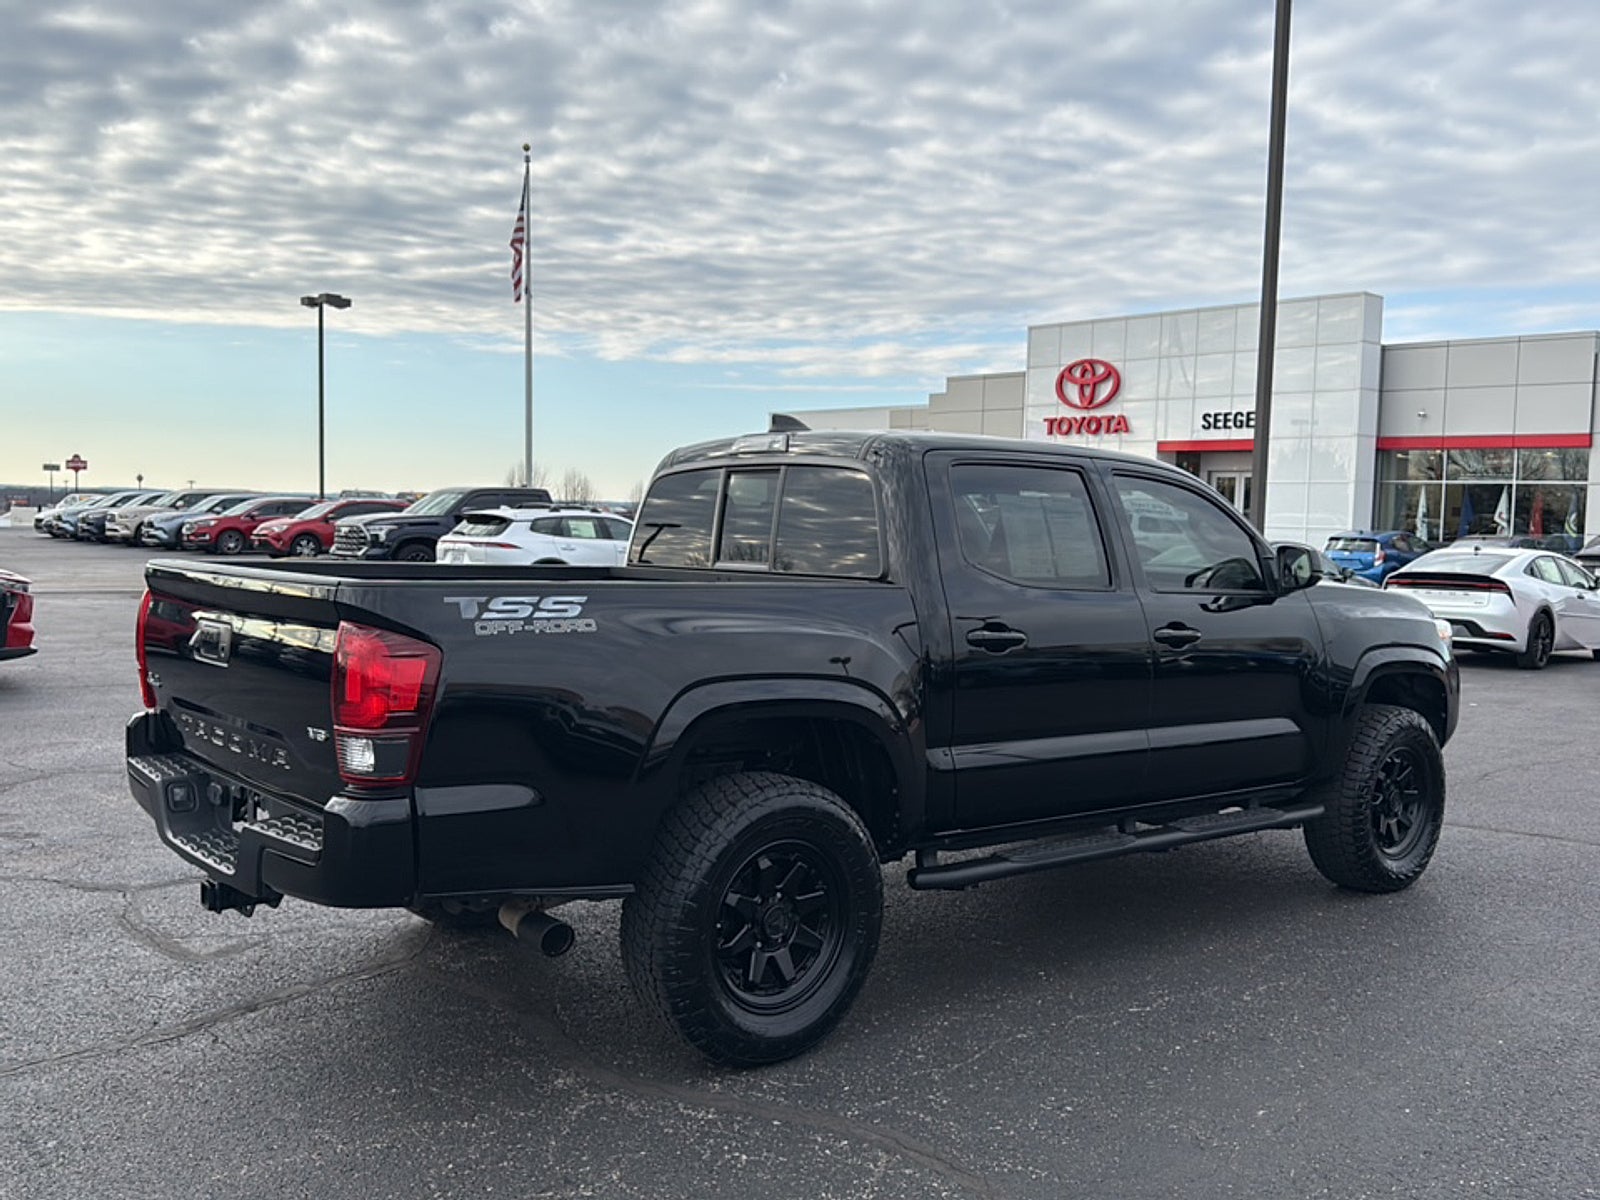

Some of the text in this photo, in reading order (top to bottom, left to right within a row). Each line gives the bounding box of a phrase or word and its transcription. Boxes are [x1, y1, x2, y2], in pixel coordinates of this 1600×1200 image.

[1043, 415, 1129, 436] TOYOTA
[443, 596, 588, 619] TSS
[475, 618, 597, 636] OFF-ROAD
